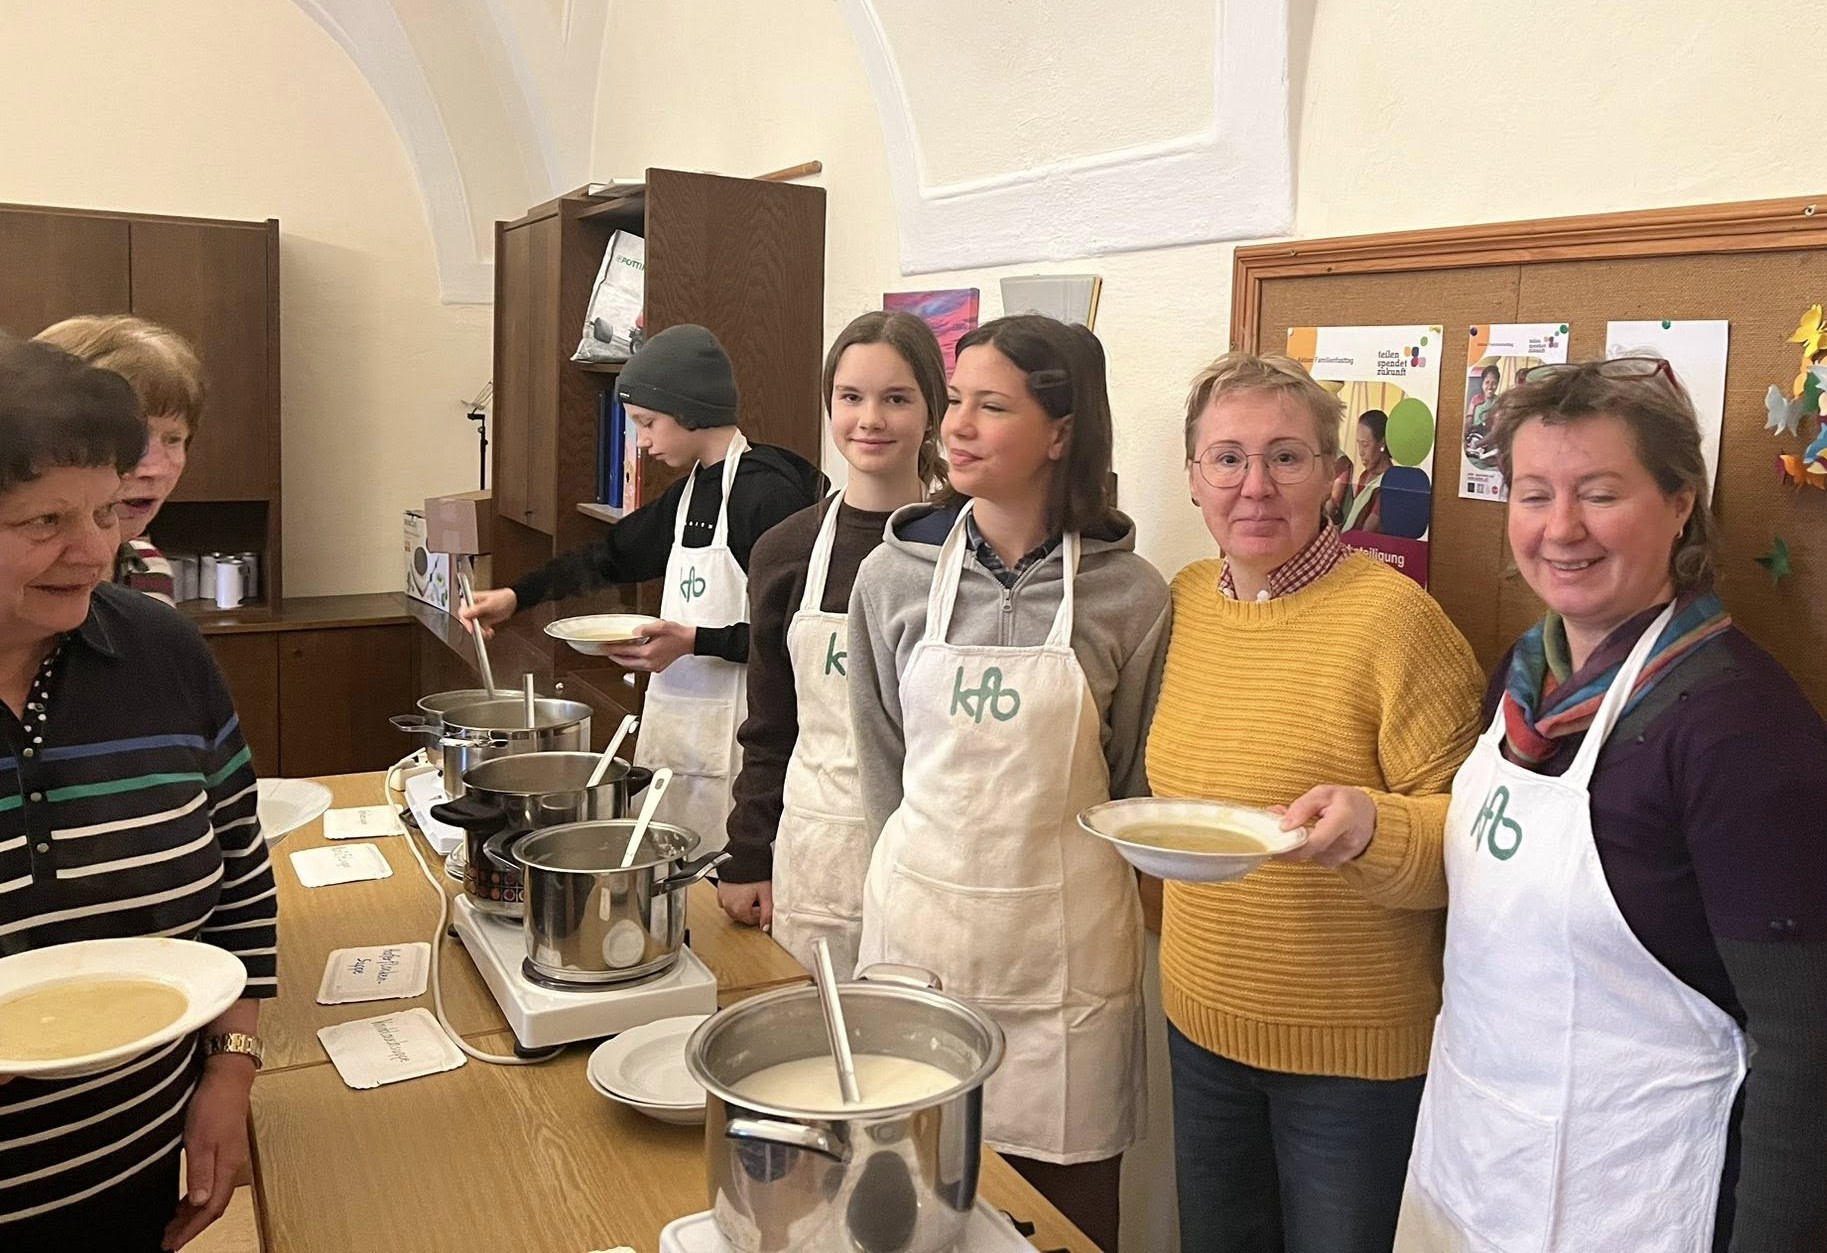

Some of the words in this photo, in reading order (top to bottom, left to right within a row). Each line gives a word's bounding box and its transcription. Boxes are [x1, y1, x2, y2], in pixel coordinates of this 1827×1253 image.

[1378, 350, 1400, 359] teilen
[1377, 359, 1407, 369] spendet
[1377, 367, 1406, 376] zukunft
[949, 666, 1021, 723] kfb
